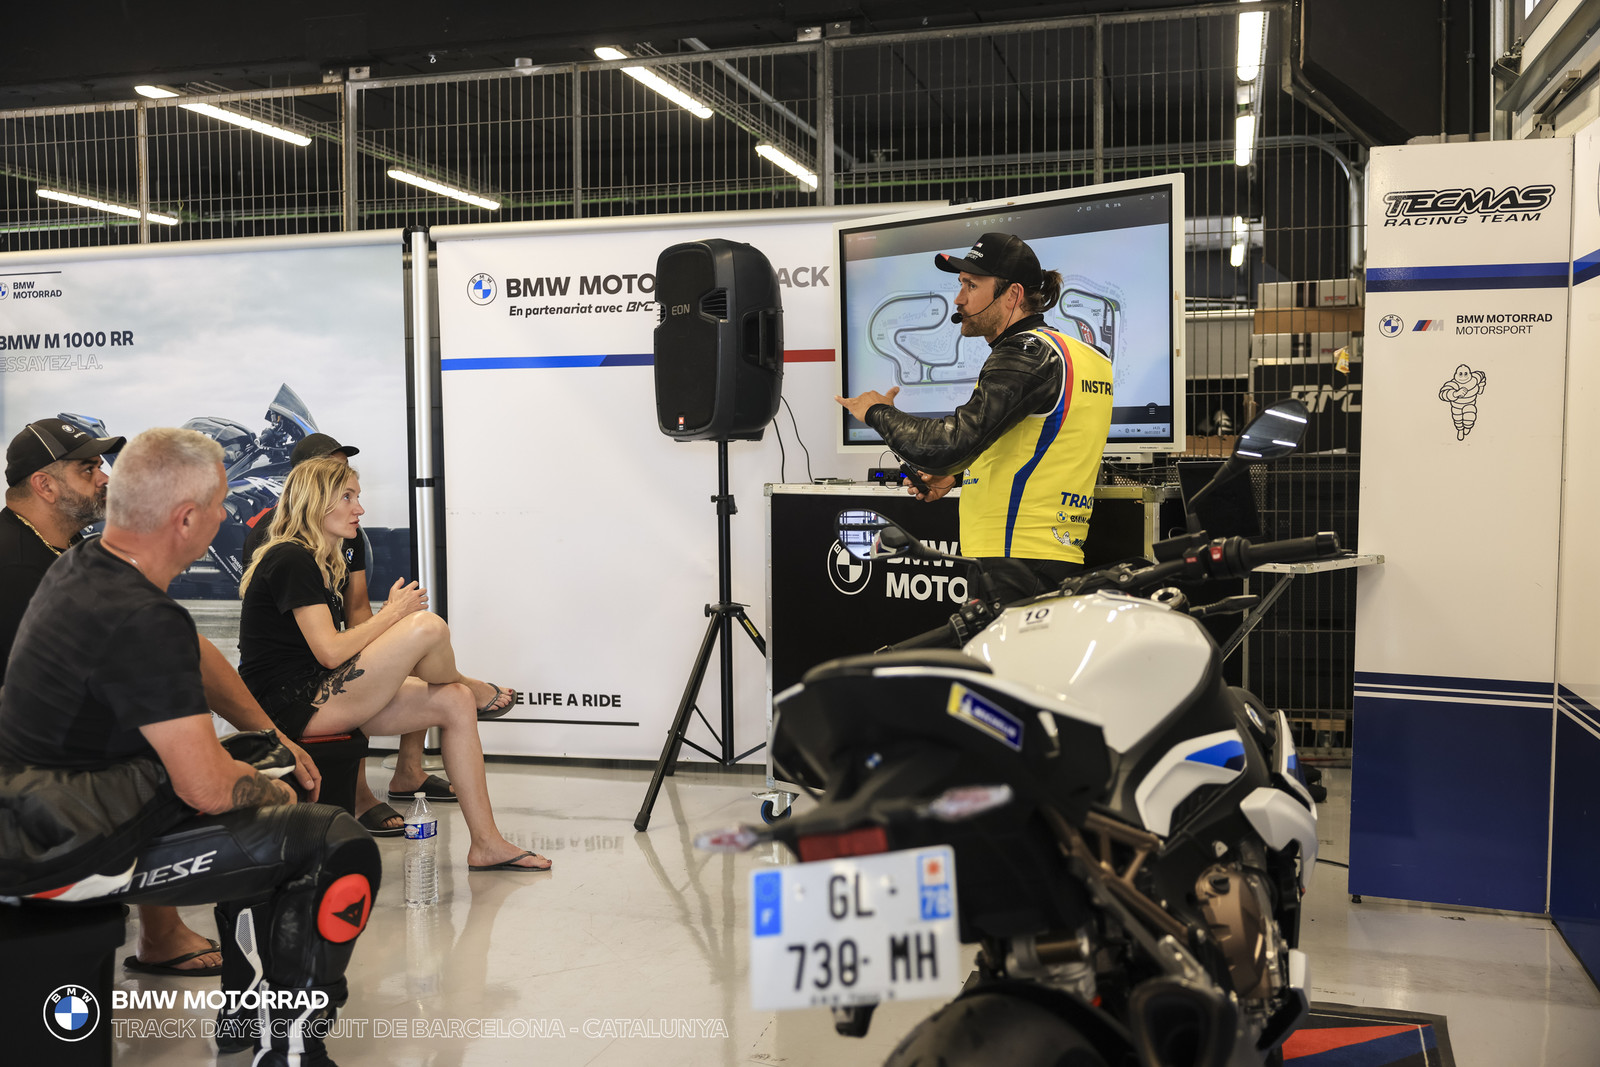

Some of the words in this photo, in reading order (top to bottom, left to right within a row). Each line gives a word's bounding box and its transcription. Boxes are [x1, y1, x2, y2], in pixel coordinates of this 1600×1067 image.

[1383, 184, 1556, 217] TECMAS
[1384, 215, 1469, 227] RACING
[1480, 212, 1542, 224] TEAM
[13, 281, 35, 290] BMW
[506, 276, 571, 298] BMW
[579, 273, 657, 296] MOTO
[777, 265, 830, 288] ACK
[13, 289, 62, 299] MOTORRAD
[509, 305, 524, 316] En
[525, 302, 592, 318] partenariat
[594, 304, 623, 313] avec
[671, 303, 691, 316] EON
[1456, 314, 1485, 324] BMW
[1486, 313, 1553, 323] MOTORRAD
[1455, 325, 1533, 335] MOTORSPORT
[0, 334, 40, 350] BMW
[44, 333, 60, 349] M
[63, 331, 107, 348] 1000
[110, 330, 134, 347] RR
[1081, 379, 1114, 396] INSTR
[886, 572, 968, 604] MOTO
[1026, 608, 1050, 622] 10
[529, 692, 563, 706] LIFE
[566, 693, 579, 707] A
[582, 694, 622, 708] RIDE
[828, 871, 876, 921] GL
